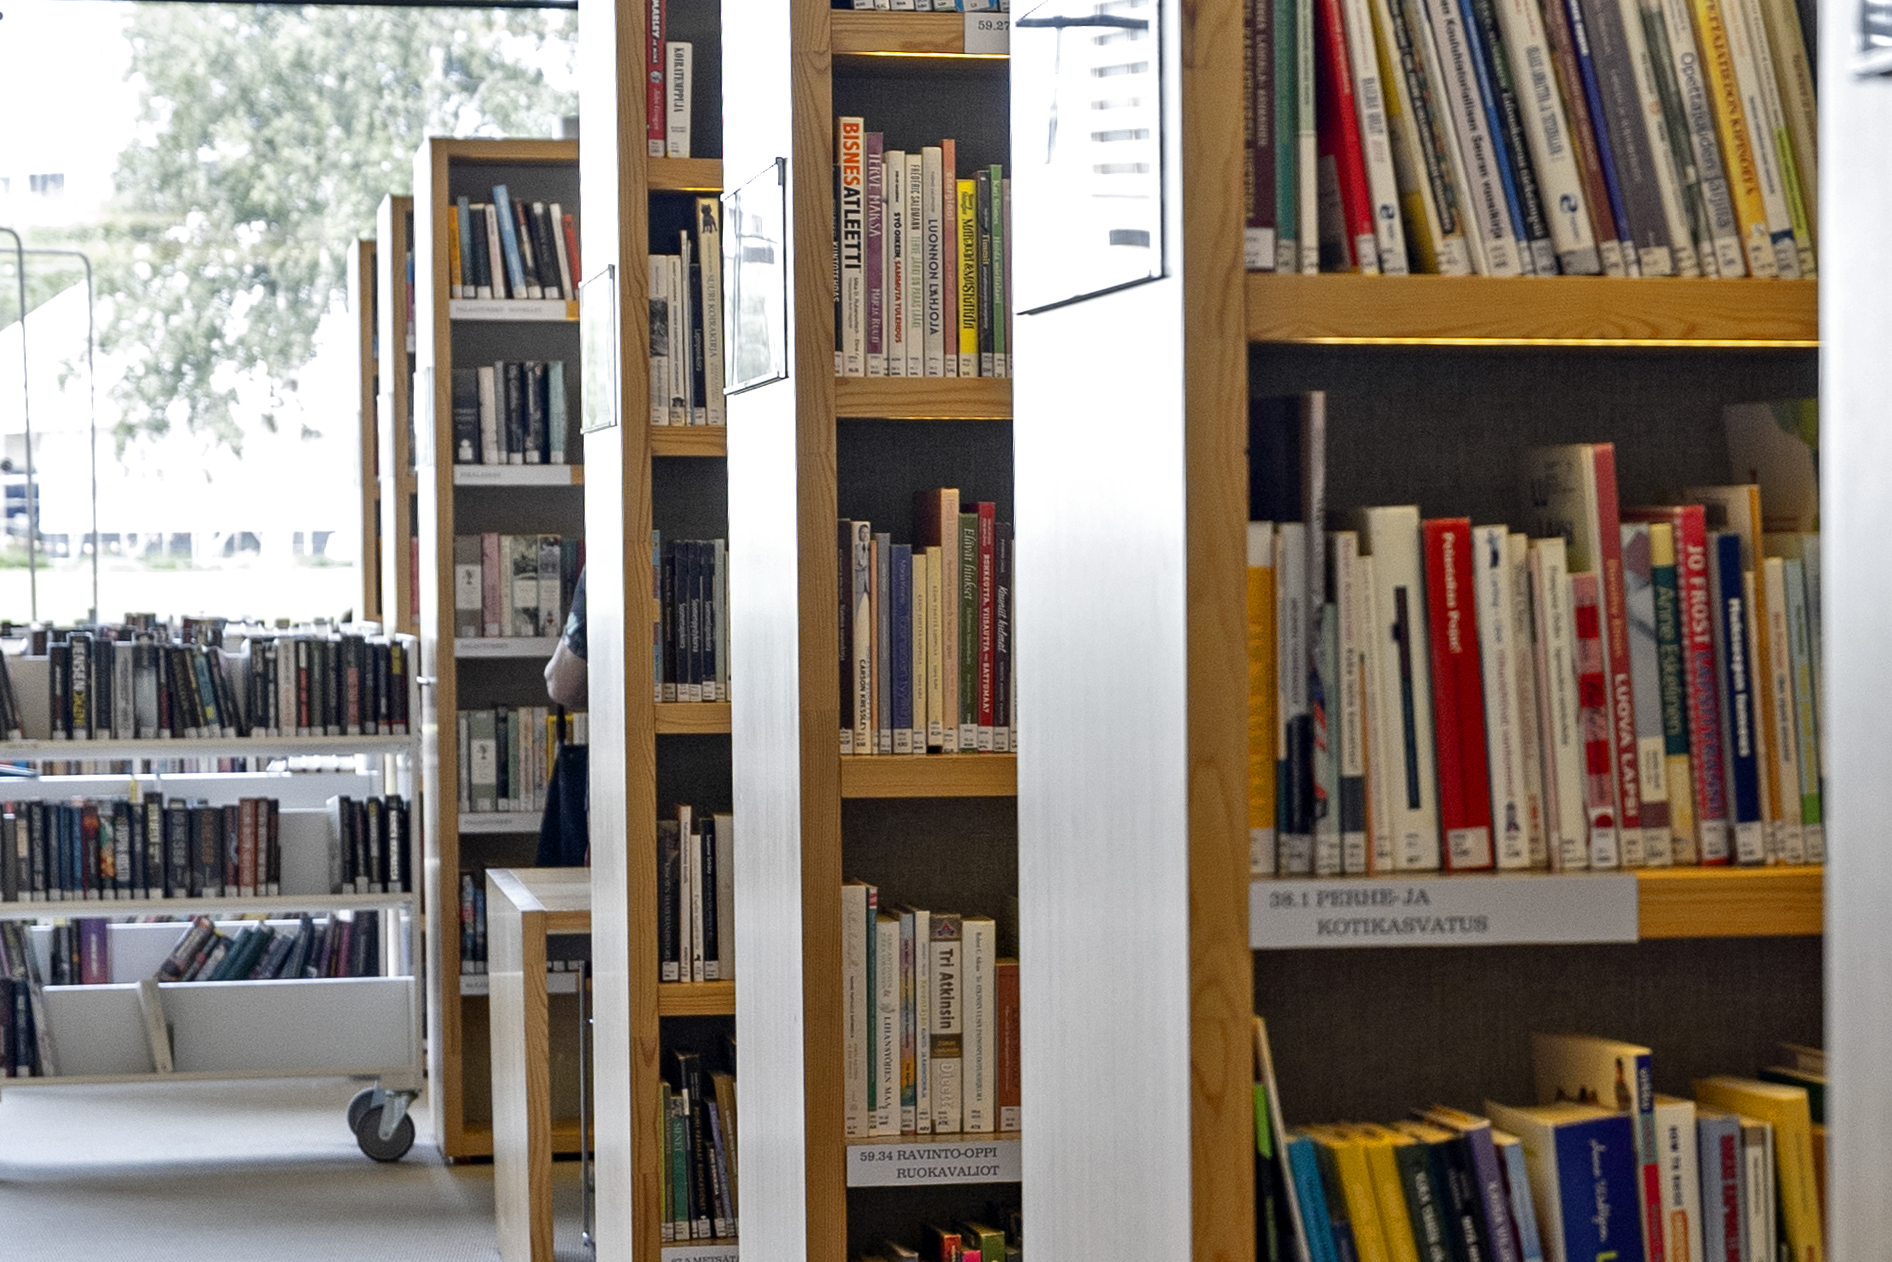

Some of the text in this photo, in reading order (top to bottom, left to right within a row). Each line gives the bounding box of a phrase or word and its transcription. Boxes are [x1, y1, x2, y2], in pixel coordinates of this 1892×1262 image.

[673, 47, 685, 112] KOIRATEMPPUJA
[1678, 52, 1719, 170] Opettajuuden
[868, 153, 881, 191] TERVE
[1470, 135, 1489, 178] Seuran
[843, 123, 862, 268] BISNESATLEETTI
[868, 195, 881, 237] MAKSA
[894, 212, 902, 227] SYÖ
[929, 219, 939, 279] LUONNON
[706, 274, 718, 357] SUURI KOIRAKIRJA
[929, 284, 939, 335] LAHJOJA
[963, 528, 976, 560] Elävät
[963, 564, 976, 599] hiukset
[1442, 532, 1458, 609] Pelastakaa
[1687, 544, 1708, 644] JO FROST
[73, 641, 87, 691] JENSEN
[1655, 585, 1683, 736] Anne Eskelinen
[1615, 673, 1633, 748] LUOVA
[1621, 752, 1639, 816] LAPSI
[1403, 888, 1431, 906] JA
[1316, 915, 1489, 935] KOTIKASVATUS
[939, 948, 955, 1028] Tri Atkinsin
[884, 1017, 893, 1082] LIHANSYÖJIEN
[674, 1122, 682, 1151] SIENET
[860, 1147, 997, 1162] 59.34 RAVINTO-OPPI
[897, 1165, 999, 1179] RUOKAVALIOT
